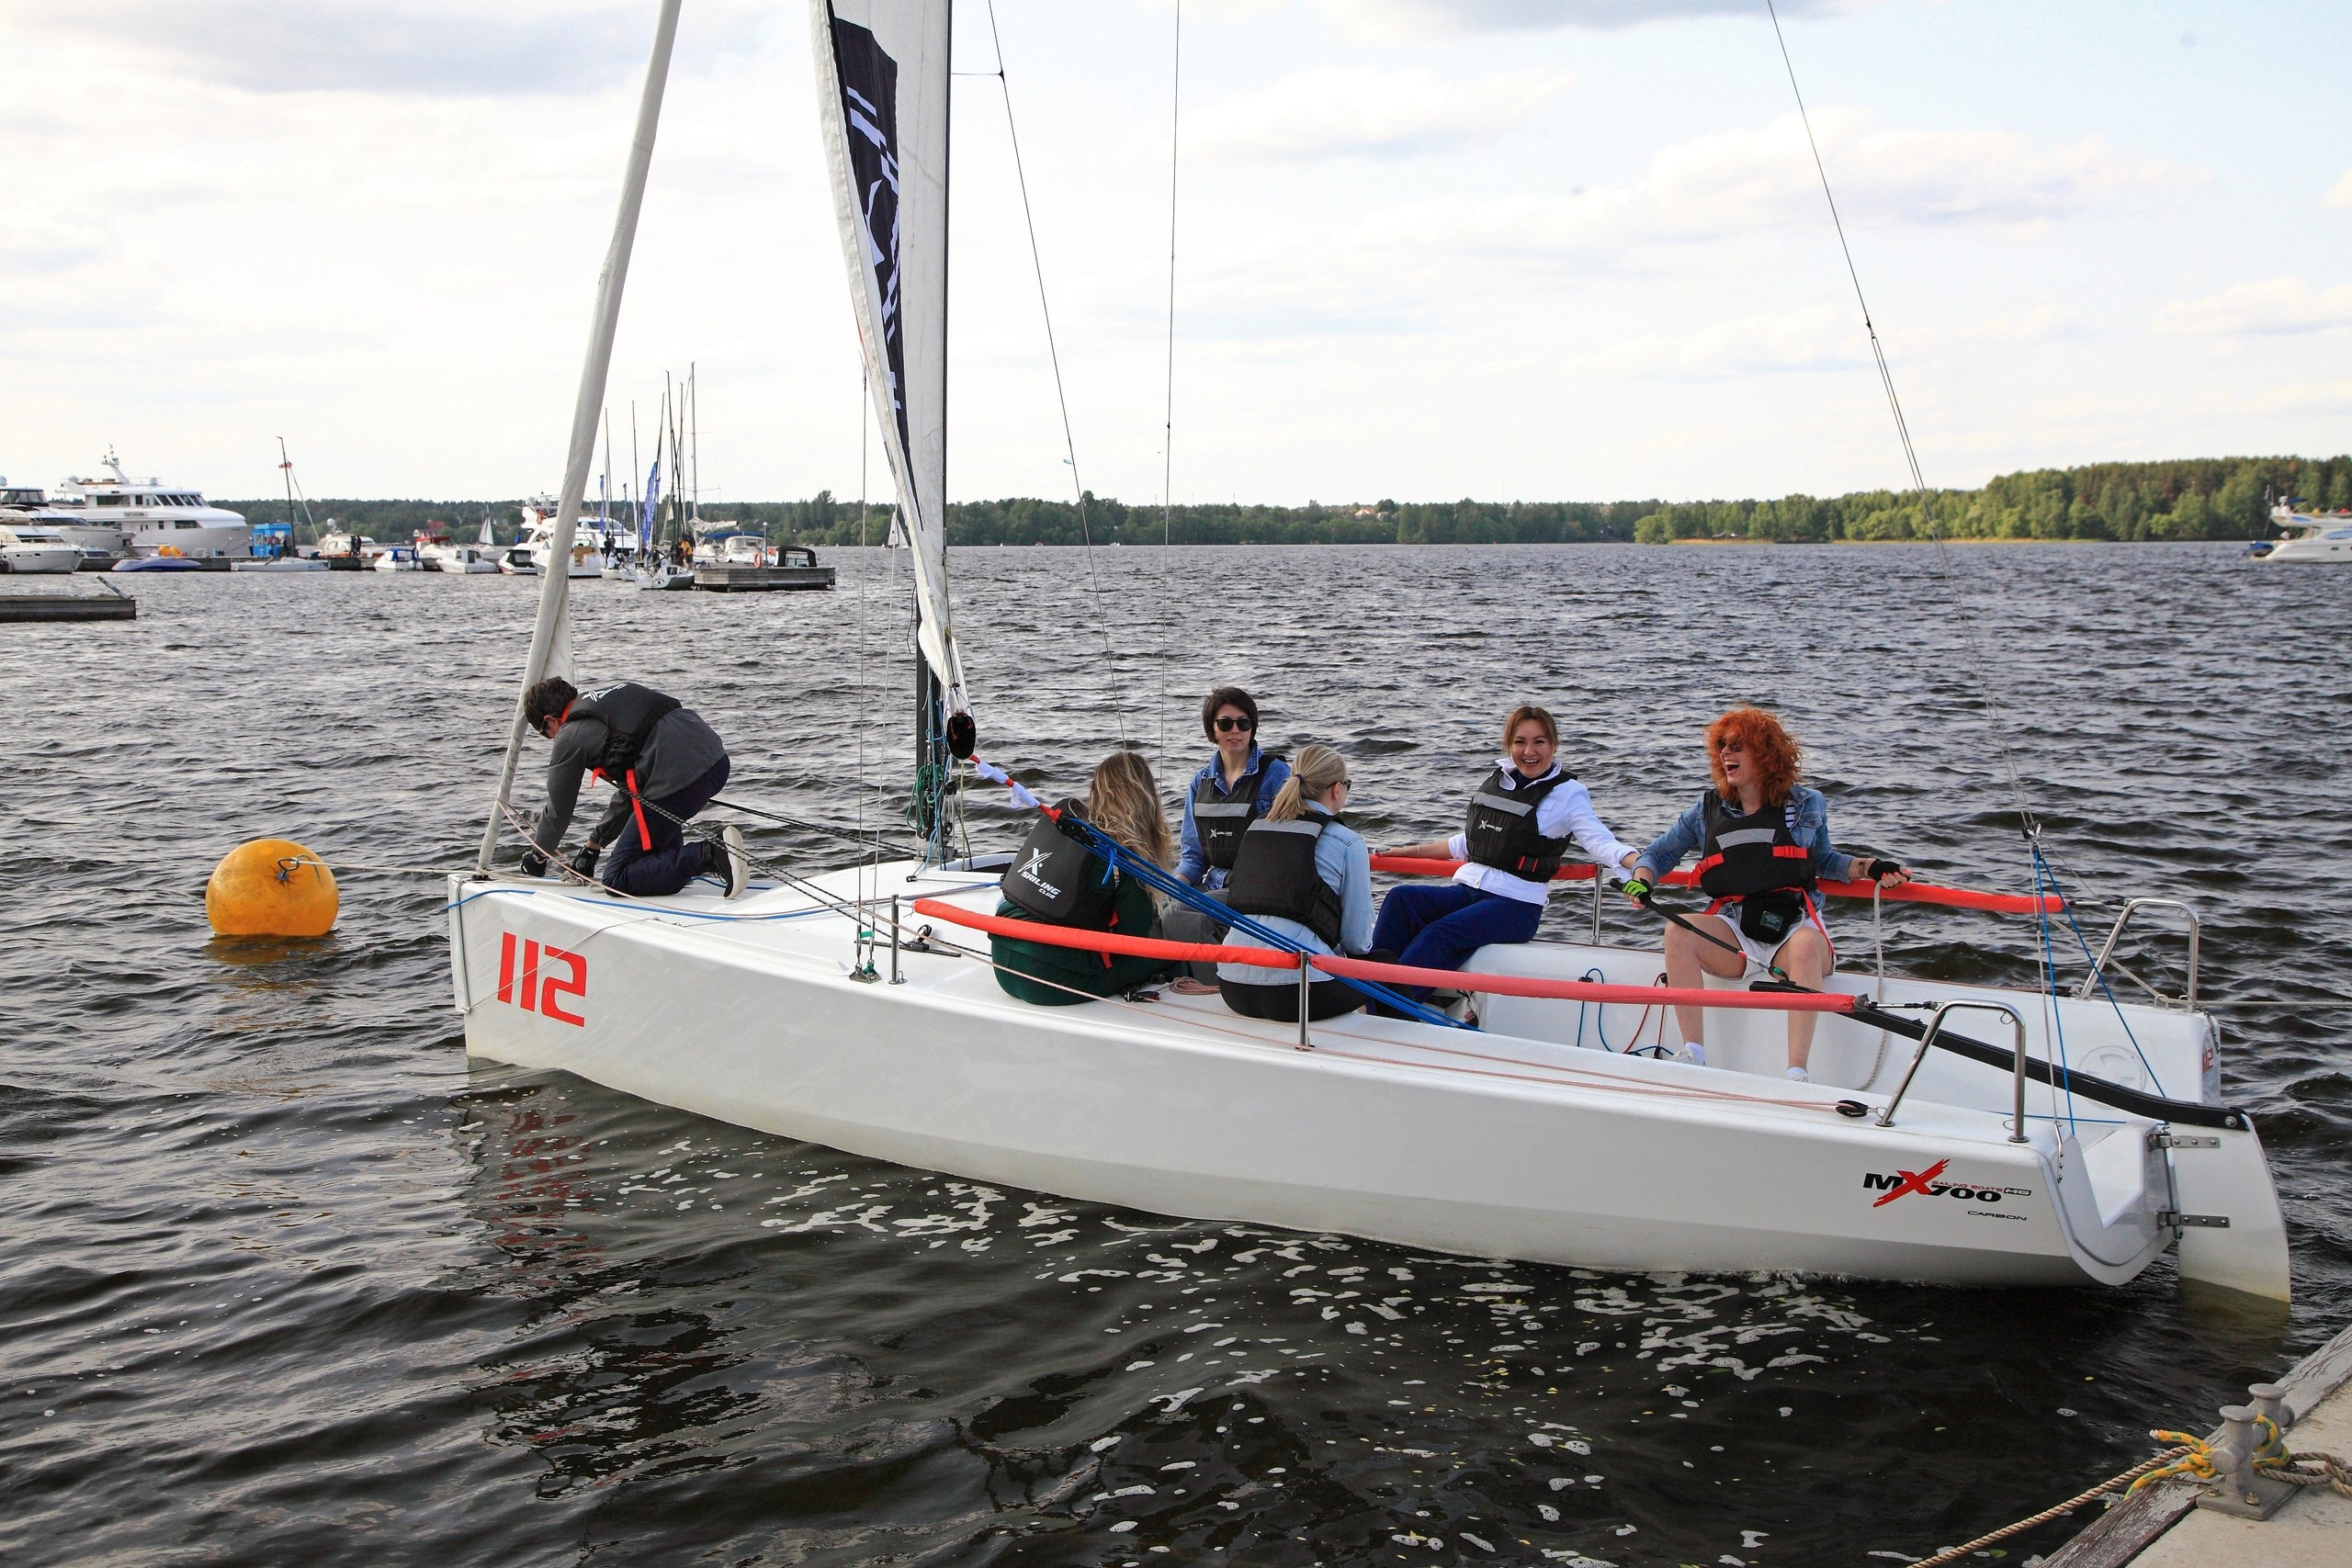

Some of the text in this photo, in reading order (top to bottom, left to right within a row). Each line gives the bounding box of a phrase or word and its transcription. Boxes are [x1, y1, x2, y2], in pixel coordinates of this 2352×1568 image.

[1021, 871, 1061, 896] SAILING
[1038, 888, 1056, 899] CLUB
[497, 931, 587, 1027] 112
[1932, 1180, 1968, 1189] SAILING
[1967, 1211, 2027, 1221] CARBON
